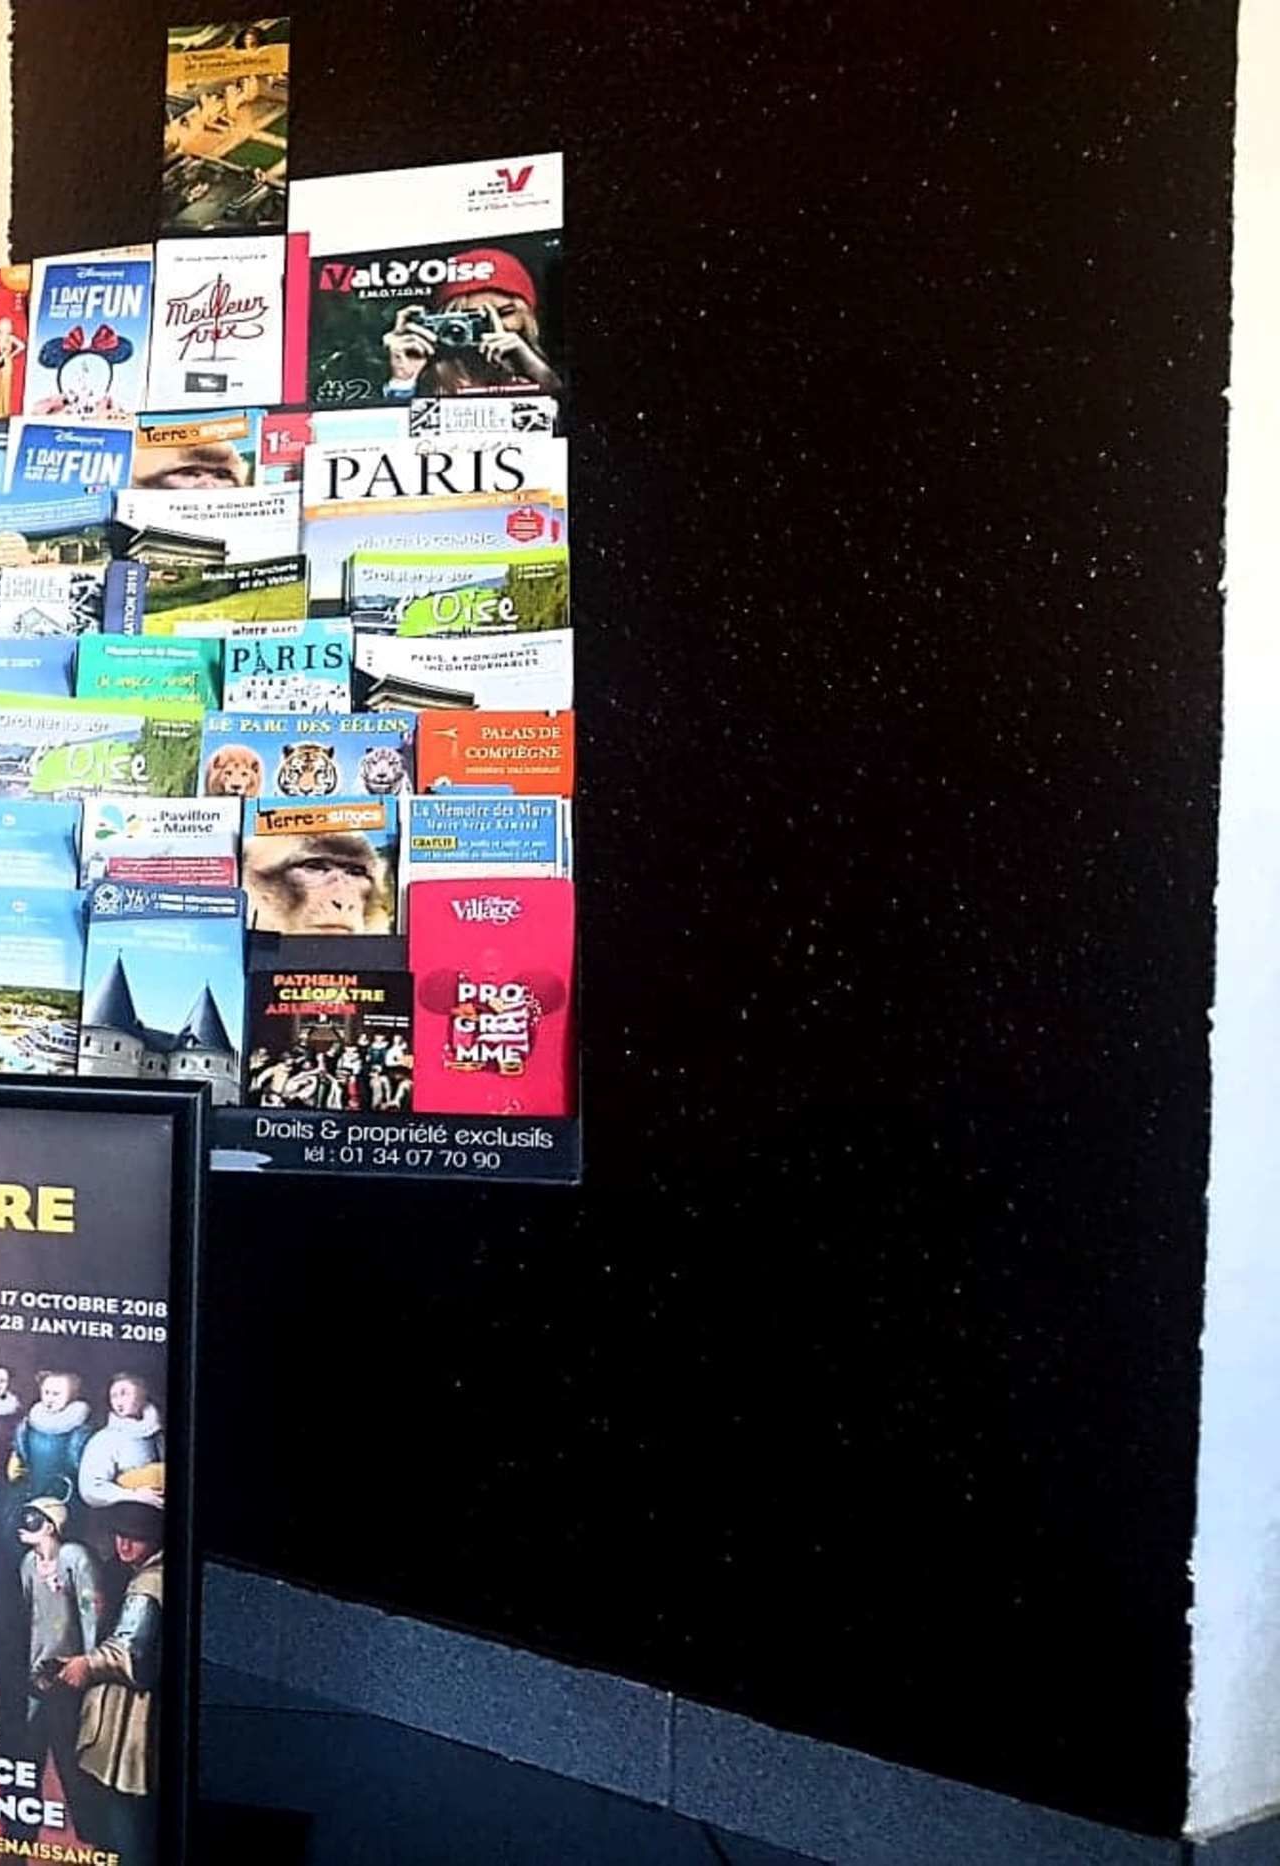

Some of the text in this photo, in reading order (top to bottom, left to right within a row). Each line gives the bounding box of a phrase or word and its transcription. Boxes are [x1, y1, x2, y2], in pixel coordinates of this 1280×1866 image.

[320, 257, 495, 293] Val d'Oise
[61, 286, 88, 304] DAY
[86, 285, 144, 320] FUN
[166, 275, 270, 328] Meilleur
[141, 426, 188, 443] Terre
[37, 450, 65, 467] DAY
[61, 451, 123, 487] FUN
[324, 446, 525, 500] PARIS
[232, 641, 342, 674] PARIS
[240, 717, 289, 733] PARC
[296, 718, 332, 733] DES
[480, 725, 562, 740] PALAIS DE
[464, 743, 562, 760] COMPIÈGNE
[159, 808, 221, 823] Pavillon
[259, 810, 314, 830] Terre
[162, 821, 214, 835] Manse
[272, 973, 358, 988] PATHELIN
[279, 985, 386, 1002] CLÉOPÂTRE
[457, 982, 525, 1004] PRO
[256, 1118, 555, 1149] Droits & propriété exclusifs
[304, 1146, 502, 1170] tél 01 34 07 70 90
[0, 1289, 170, 1319] 17 OCTOBRE 2018
[30, 1316, 114, 1341] JANVIER
[121, 1324, 168, 1344] 2019
